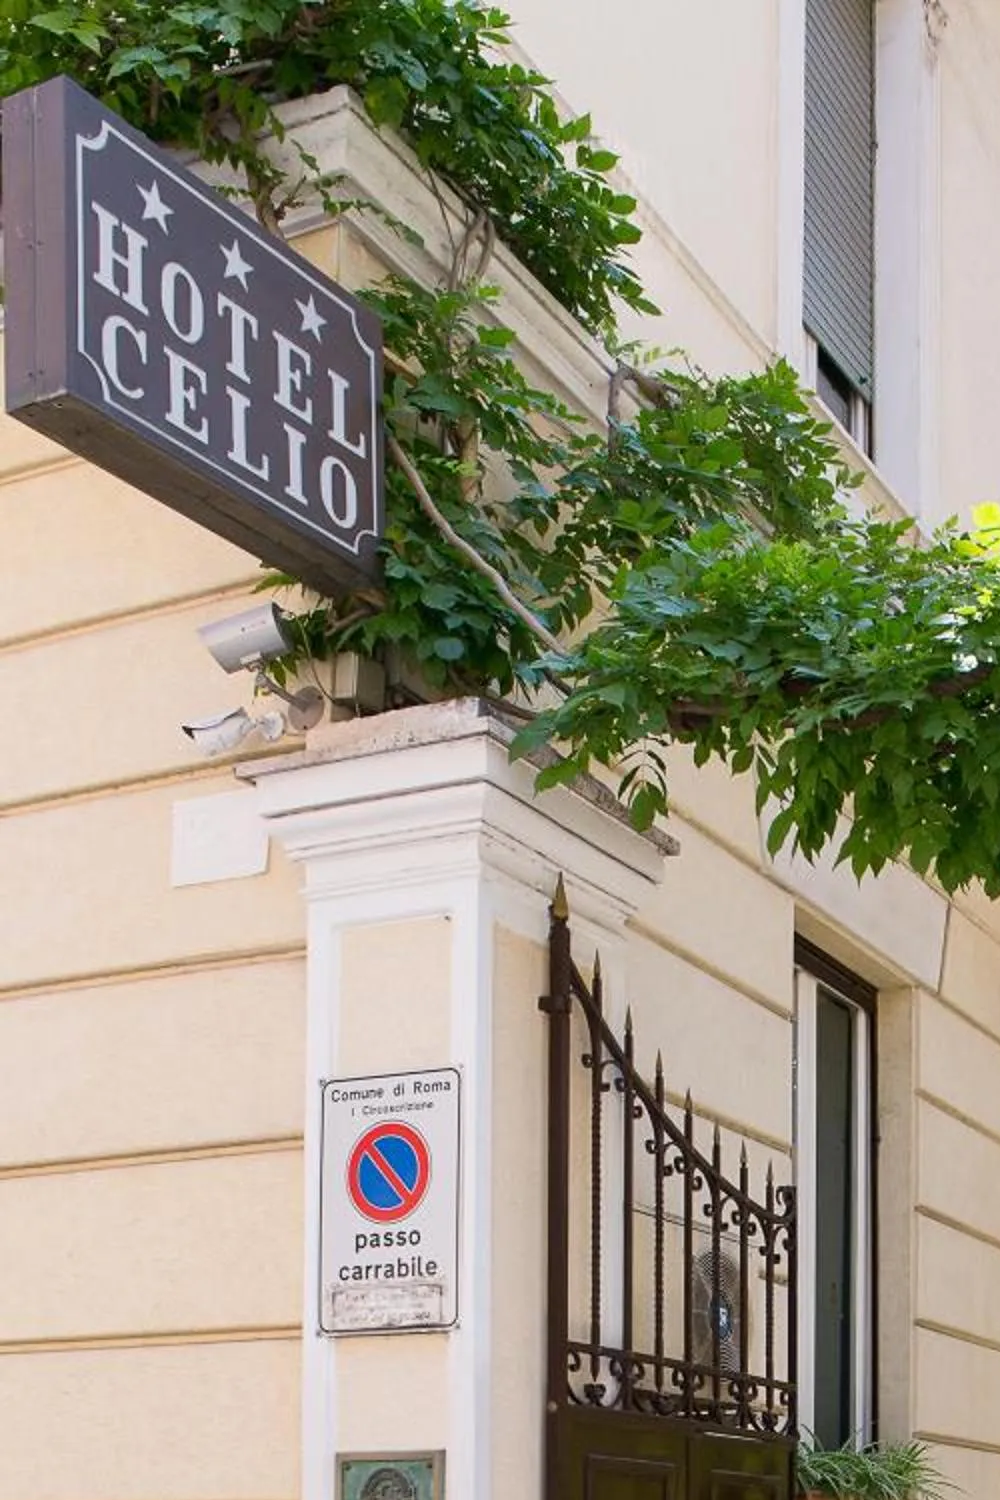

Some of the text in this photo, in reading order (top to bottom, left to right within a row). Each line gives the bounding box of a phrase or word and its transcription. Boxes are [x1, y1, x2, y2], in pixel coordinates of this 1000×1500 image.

[92, 201, 366, 458] HOTEL
[101, 314, 358, 529] CELIO
[331, 1080, 451, 1102] Comune di Roma
[355, 1228, 422, 1252] passo
[339, 1256, 437, 1281] carrabile
